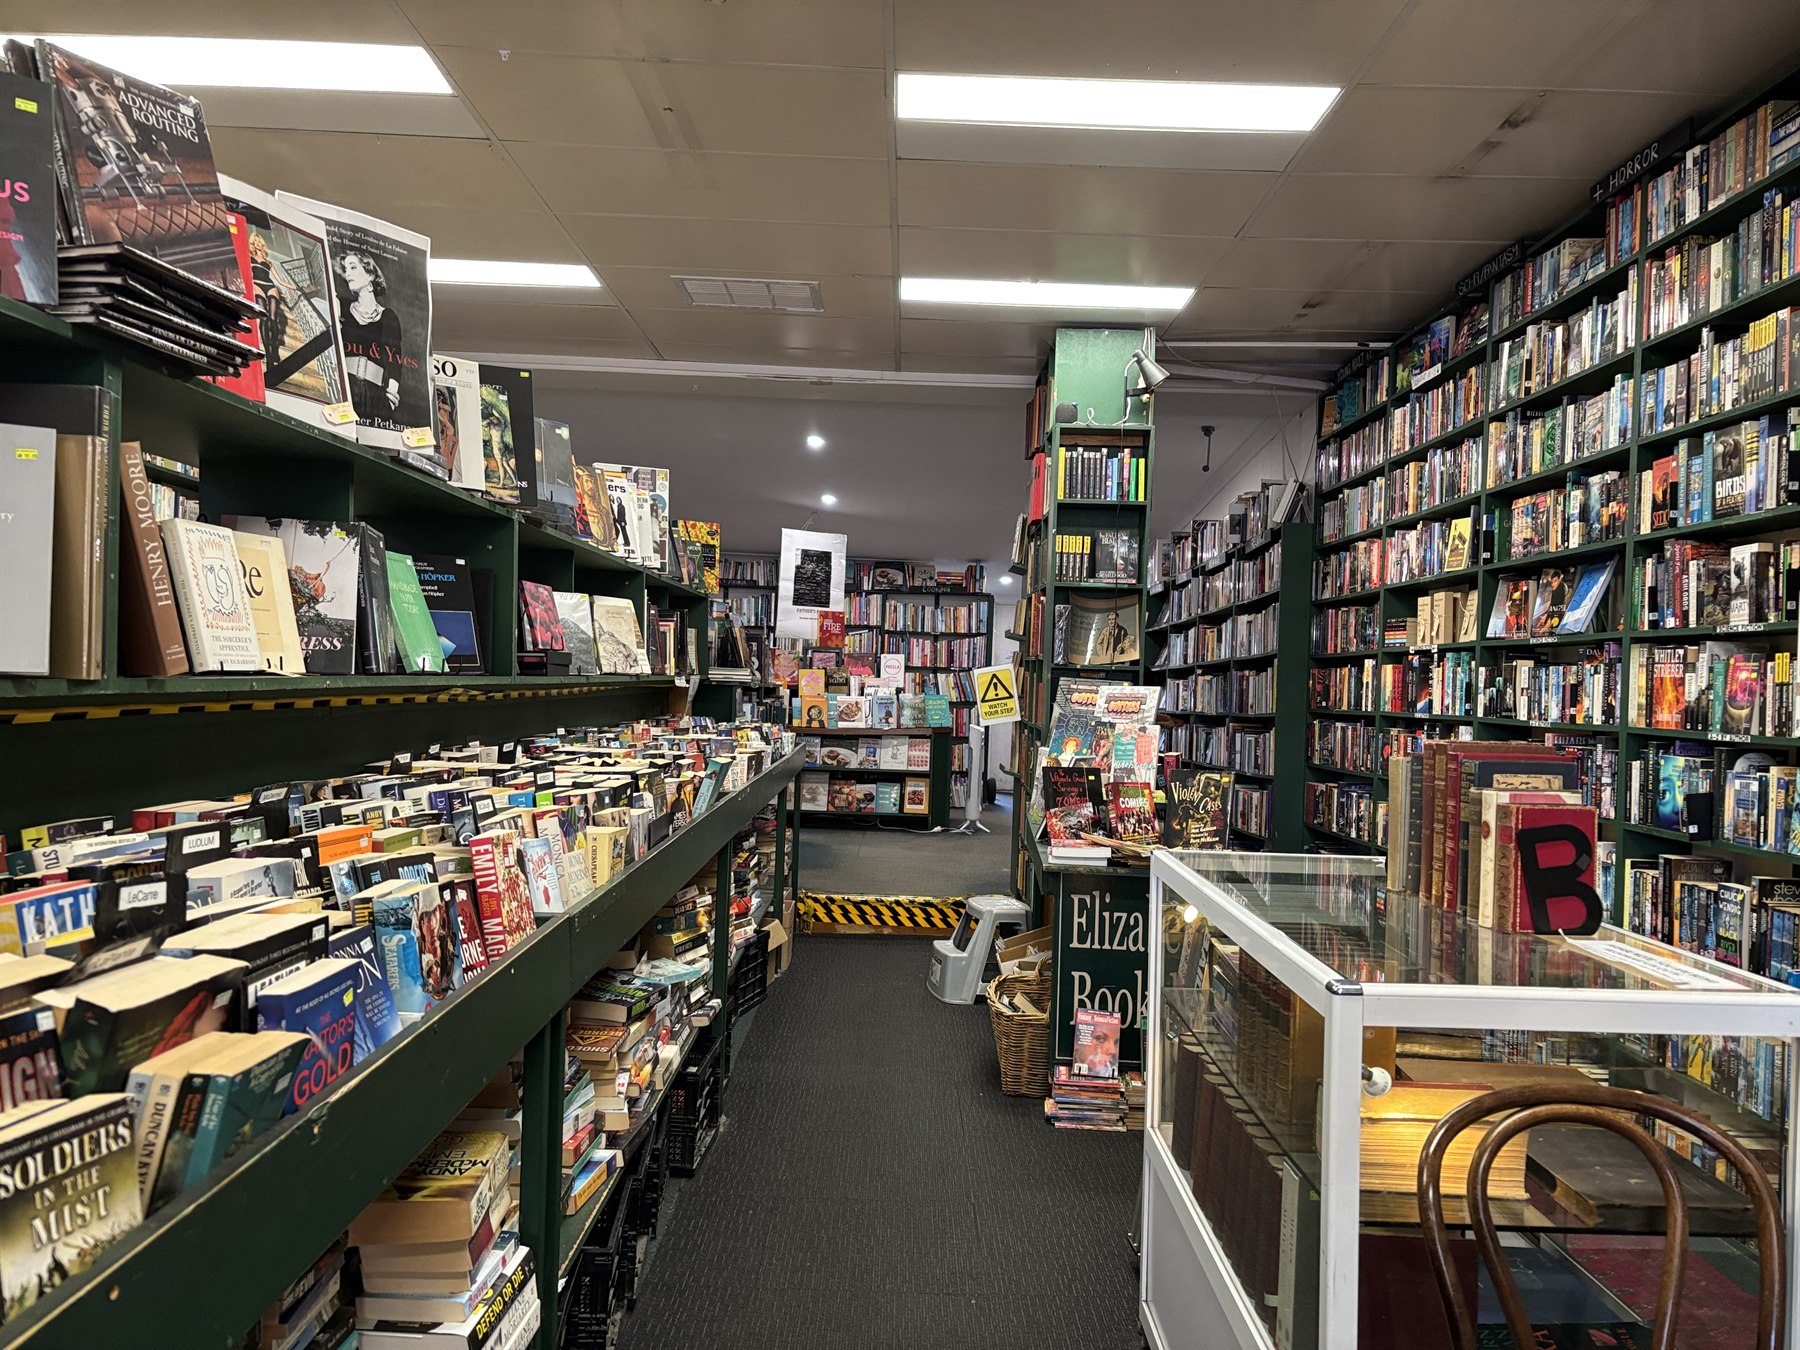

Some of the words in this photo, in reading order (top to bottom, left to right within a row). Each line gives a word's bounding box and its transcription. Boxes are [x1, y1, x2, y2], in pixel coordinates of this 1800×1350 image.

[118, 90, 196, 130] ADVANCED
[132, 107, 199, 144] ROUTING
[1609, 142, 1659, 192] HORROR
[338, 226, 354, 238] Story
[369, 342, 381, 359] &
[385, 346, 419, 369] Yves
[126, 452, 156, 529] MOORE
[1715, 475, 1746, 499] BIRDS
[143, 539, 172, 608] HENRY
[823, 621, 842, 631] FIRE
[1718, 624, 1740, 633] SCIENCE
[1740, 623, 1763, 632] FICTION
[211, 635, 225, 643] THE
[225, 635, 253, 644] SORCERER'S
[219, 644, 250, 652] APPRENTICE
[1654, 648, 1685, 664] WHITLEY
[1653, 663, 1685, 678] STRIEBER
[984, 708, 1000, 717] YOUR
[1000, 707, 1014, 715] STEP
[988, 702, 1008, 710] WATCH
[1729, 735, 1751, 743] AUTHOR
[1171, 781, 1203, 806] VIOLENT
[1199, 797, 1222, 815] CASES
[366, 811, 383, 819] ANDY
[188, 835, 216, 849] LUDLUM
[472, 844, 498, 893] EMILY
[550, 833, 566, 881] MONICA
[1517, 823, 1604, 935] B
[1773, 880, 1800, 895] stev
[128, 888, 159, 904] LeCarre
[21, 892, 97, 943] KATH
[1069, 890, 1146, 953] Eliza
[1718, 927, 1738, 940] BLACK
[381, 934, 407, 992] SEAFARERS
[1069, 969, 1149, 1030] Book
[319, 1011, 332, 1026] THE
[293, 1042, 351, 1106] GOLD
[141, 1102, 166, 1160] DUNCAN
[0, 1117, 132, 1200] SOLDIERS
[416, 1167, 471, 1176] ANDY
[33, 1186, 56, 1212] IN
[62, 1165, 102, 1197] THE
[30, 1185, 111, 1251] MIST
[474, 1296, 504, 1340] DEFEND
[502, 1281, 514, 1302] OR
[511, 1265, 525, 1288] DIE
